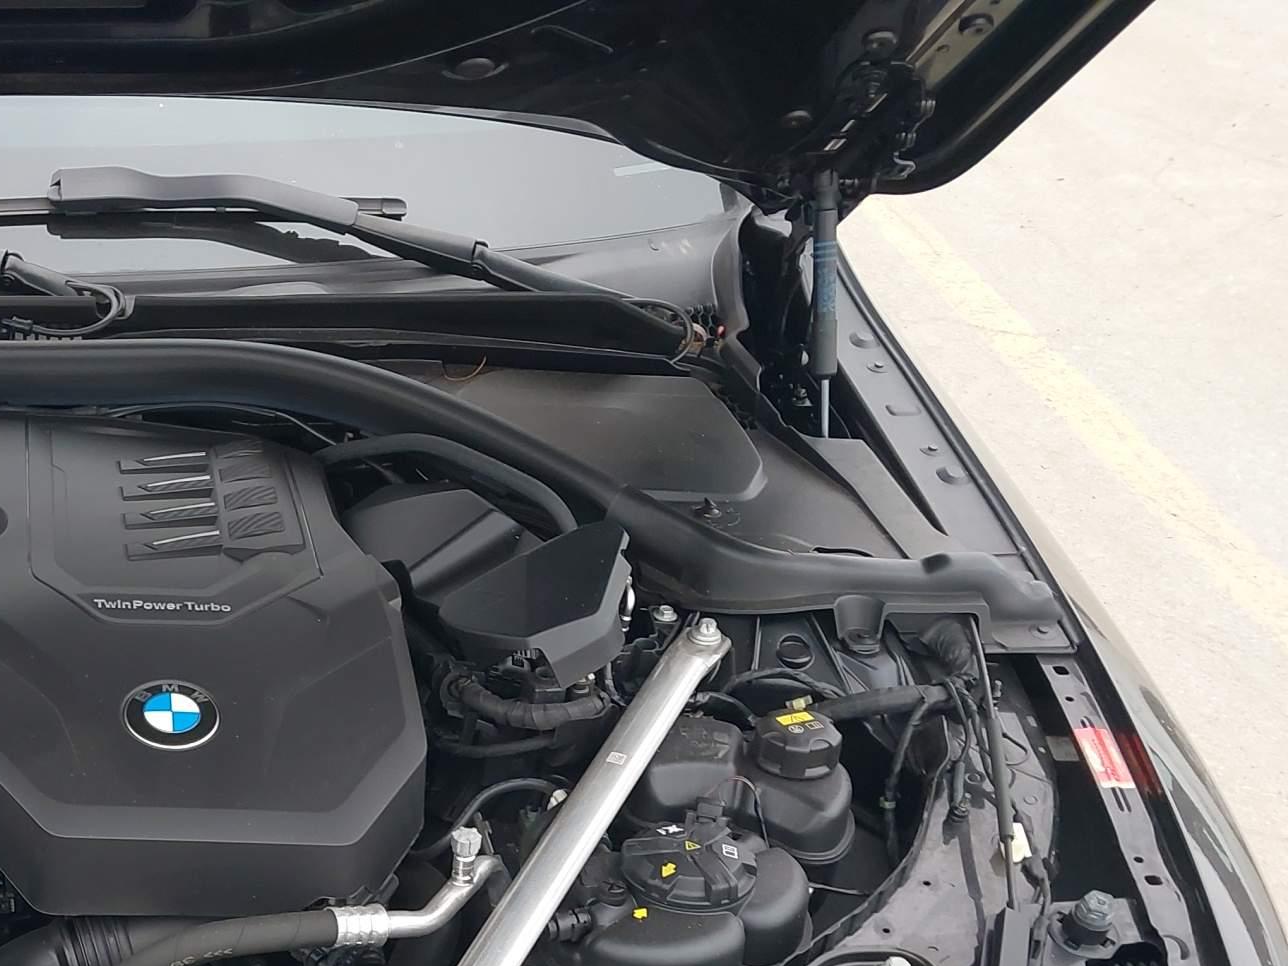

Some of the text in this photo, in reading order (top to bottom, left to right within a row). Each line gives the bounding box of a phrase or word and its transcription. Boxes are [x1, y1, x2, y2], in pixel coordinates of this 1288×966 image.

[93, 598, 232, 613] TwinPower Turbo
[134, 683, 209, 703] BMW
